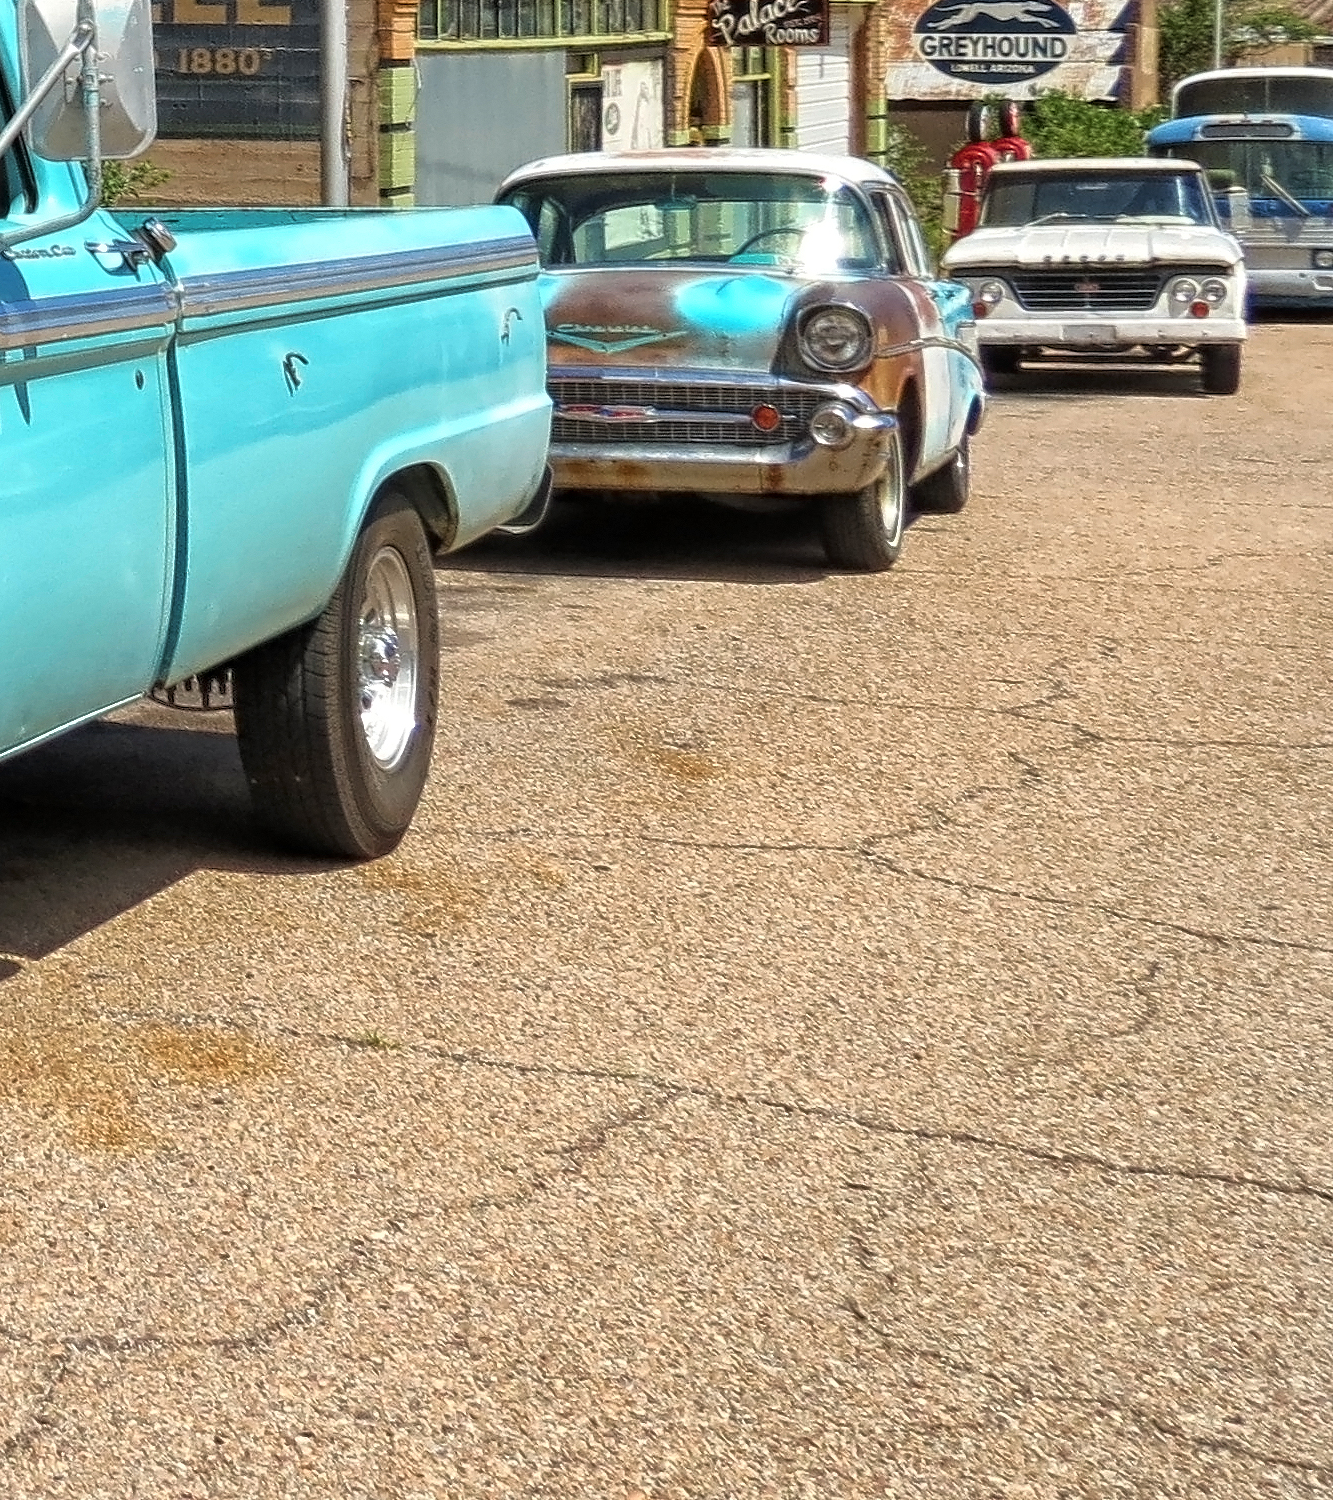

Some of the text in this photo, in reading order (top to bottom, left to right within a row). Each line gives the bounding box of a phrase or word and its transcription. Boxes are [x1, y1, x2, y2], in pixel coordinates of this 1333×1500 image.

[763, 22, 820, 46] Rooms
[919, 35, 1068, 59] GREYHOUND
[179, 48, 262, 75] 1880
